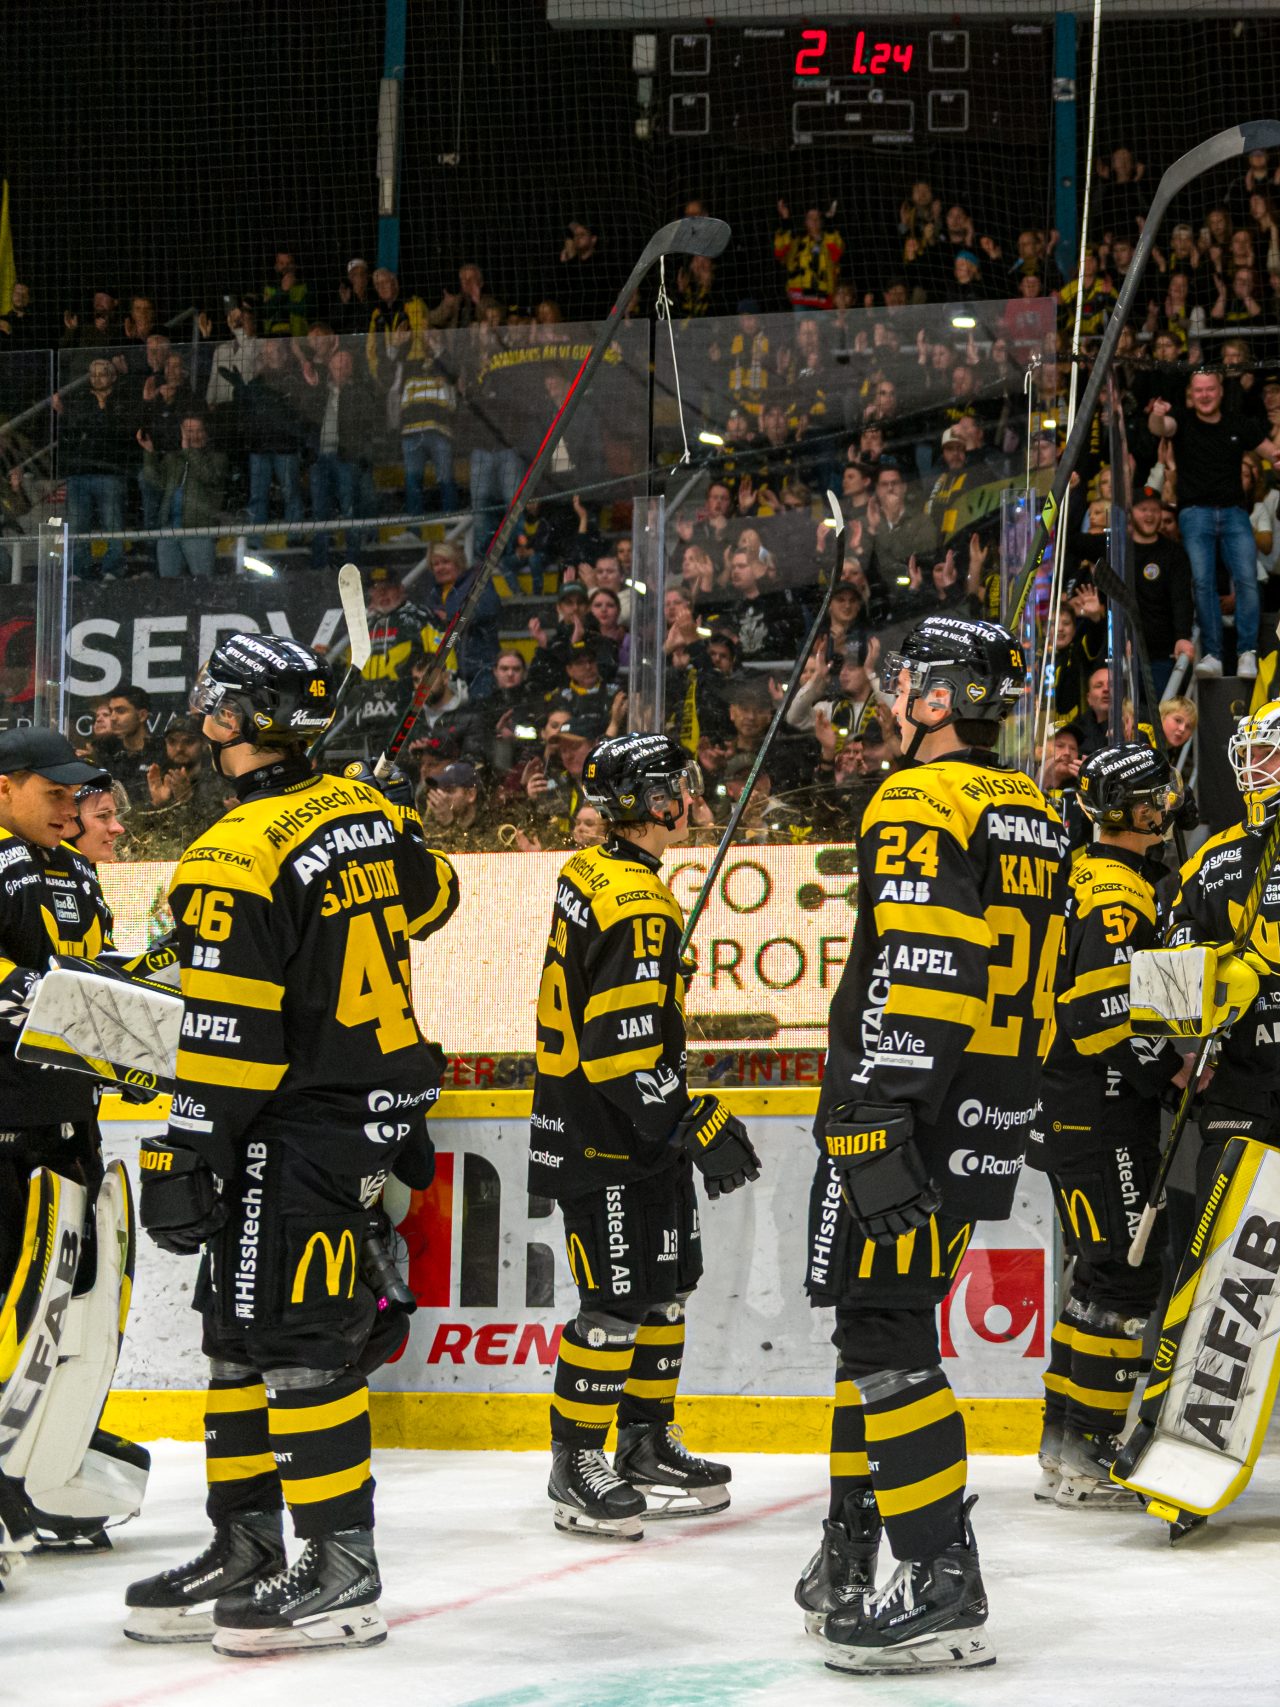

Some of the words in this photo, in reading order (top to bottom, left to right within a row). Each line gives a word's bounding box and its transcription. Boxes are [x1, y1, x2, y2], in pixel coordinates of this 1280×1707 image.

[923, 616, 997, 642] BRANTESTIG
[1009, 649, 1023, 667] 24
[308, 679, 326, 698] 46
[610, 734, 669, 757] BRANTESTIG
[587, 763, 597, 779] 19
[1101, 749, 1154, 776] BRANTESTIG
[279, 785, 352, 841] Hisstech
[884, 787, 917, 799] DÄCK
[922, 794, 952, 818] TEAM
[216, 851, 253, 869] TEAM
[874, 825, 940, 878] 24
[320, 859, 400, 917] SJÖDIN
[618, 891, 647, 904] DÄCK
[879, 880, 931, 903] ABB
[1093, 884, 1120, 893] DÄCK
[182, 888, 234, 942] 46
[632, 916, 667, 959] 19
[893, 944, 958, 977] APEL
[336, 904, 419, 1055] 4
[181, 1011, 241, 1043] APEL
[877, 1030, 926, 1054] LaVie
[246, 1142, 268, 1181] AB
[811, 1158, 842, 1266] Hisstec
[1190, 1172, 1230, 1258] WARRIOR
[235, 1188, 263, 1303] Hisstech
[611, 1263, 632, 1296] AB
[657, 1463, 688, 1479] BAUER
[183, 1566, 224, 1593] BAUER
[279, 1587, 321, 1615] BAUER
[888, 1603, 928, 1627] BAUER
